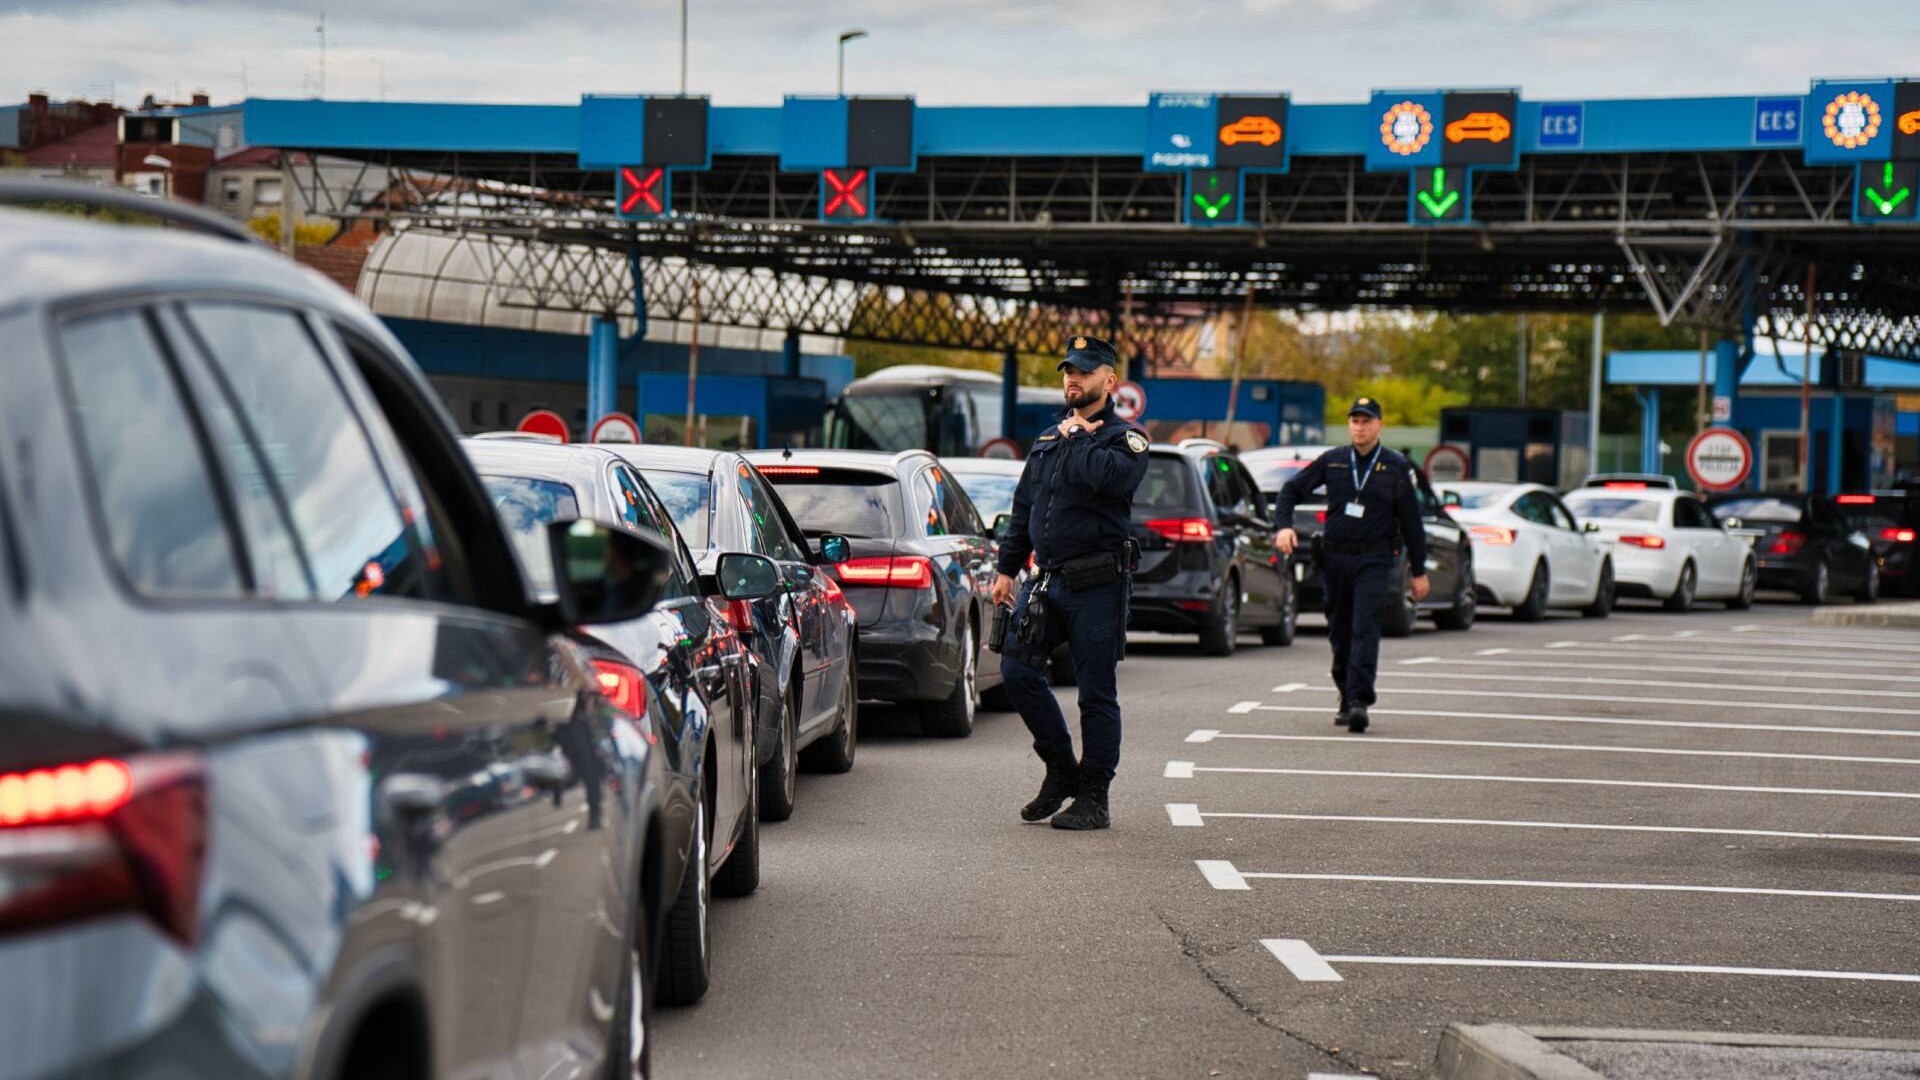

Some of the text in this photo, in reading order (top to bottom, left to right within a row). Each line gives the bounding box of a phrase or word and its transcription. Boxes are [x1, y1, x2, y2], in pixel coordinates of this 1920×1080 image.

[1543, 115, 1577, 135] EES
[1760, 111, 1796, 130] EES
[1708, 444, 1733, 455] STOP
